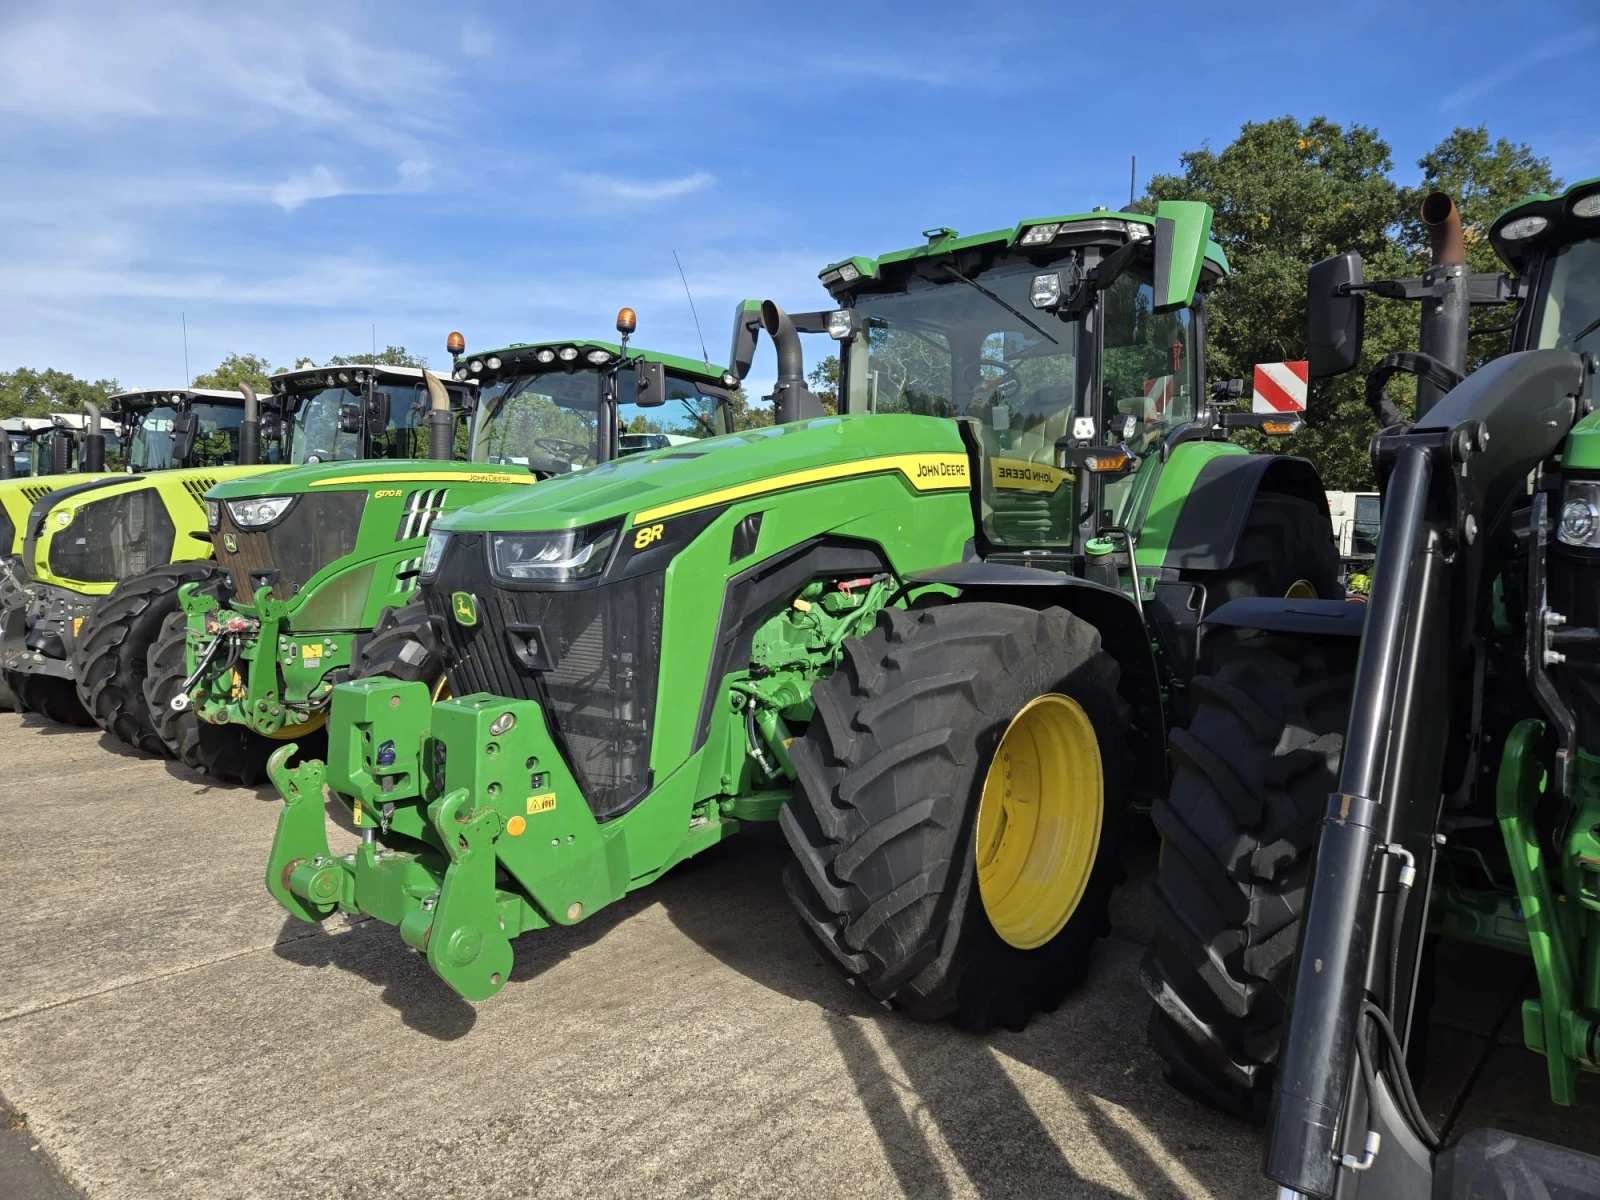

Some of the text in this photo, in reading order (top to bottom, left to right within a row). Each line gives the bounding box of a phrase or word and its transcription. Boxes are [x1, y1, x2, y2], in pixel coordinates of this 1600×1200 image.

[917, 462, 966, 478] JOHN DEERE
[469, 474, 511, 483] JOHN DEERE
[634, 523, 664, 549] 8R
